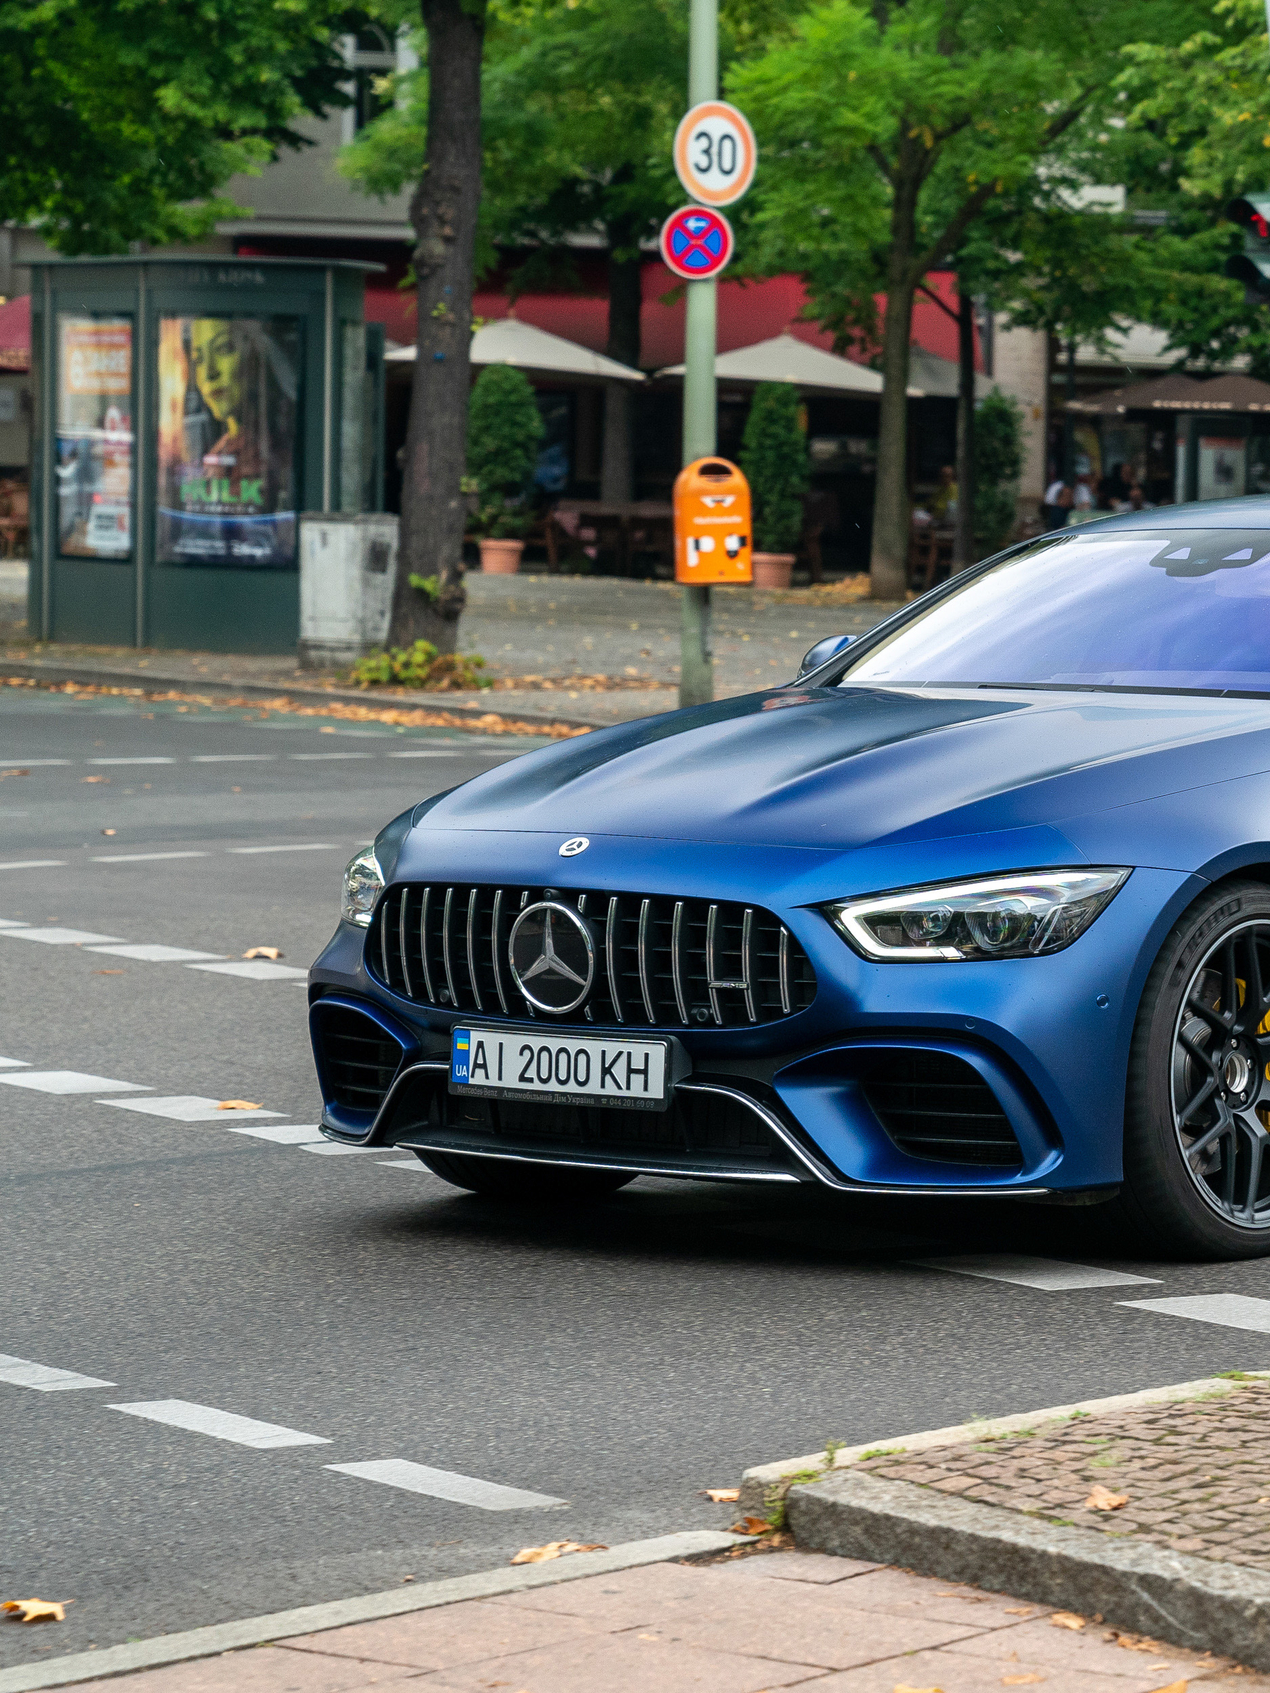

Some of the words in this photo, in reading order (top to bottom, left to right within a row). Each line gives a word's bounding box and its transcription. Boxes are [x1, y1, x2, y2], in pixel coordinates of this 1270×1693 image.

[694, 131, 737, 176] 30
[180, 477, 265, 506] HULK
[455, 1064, 468, 1078] UA
[470, 1039, 504, 1082] AI
[518, 1043, 591, 1088] 2000
[600, 1049, 650, 1092] KH
[457, 1084, 498, 1097] Mercedes-Benz
[567, 1094, 595, 1106] Україна
[622, 1098, 635, 1107] 201
